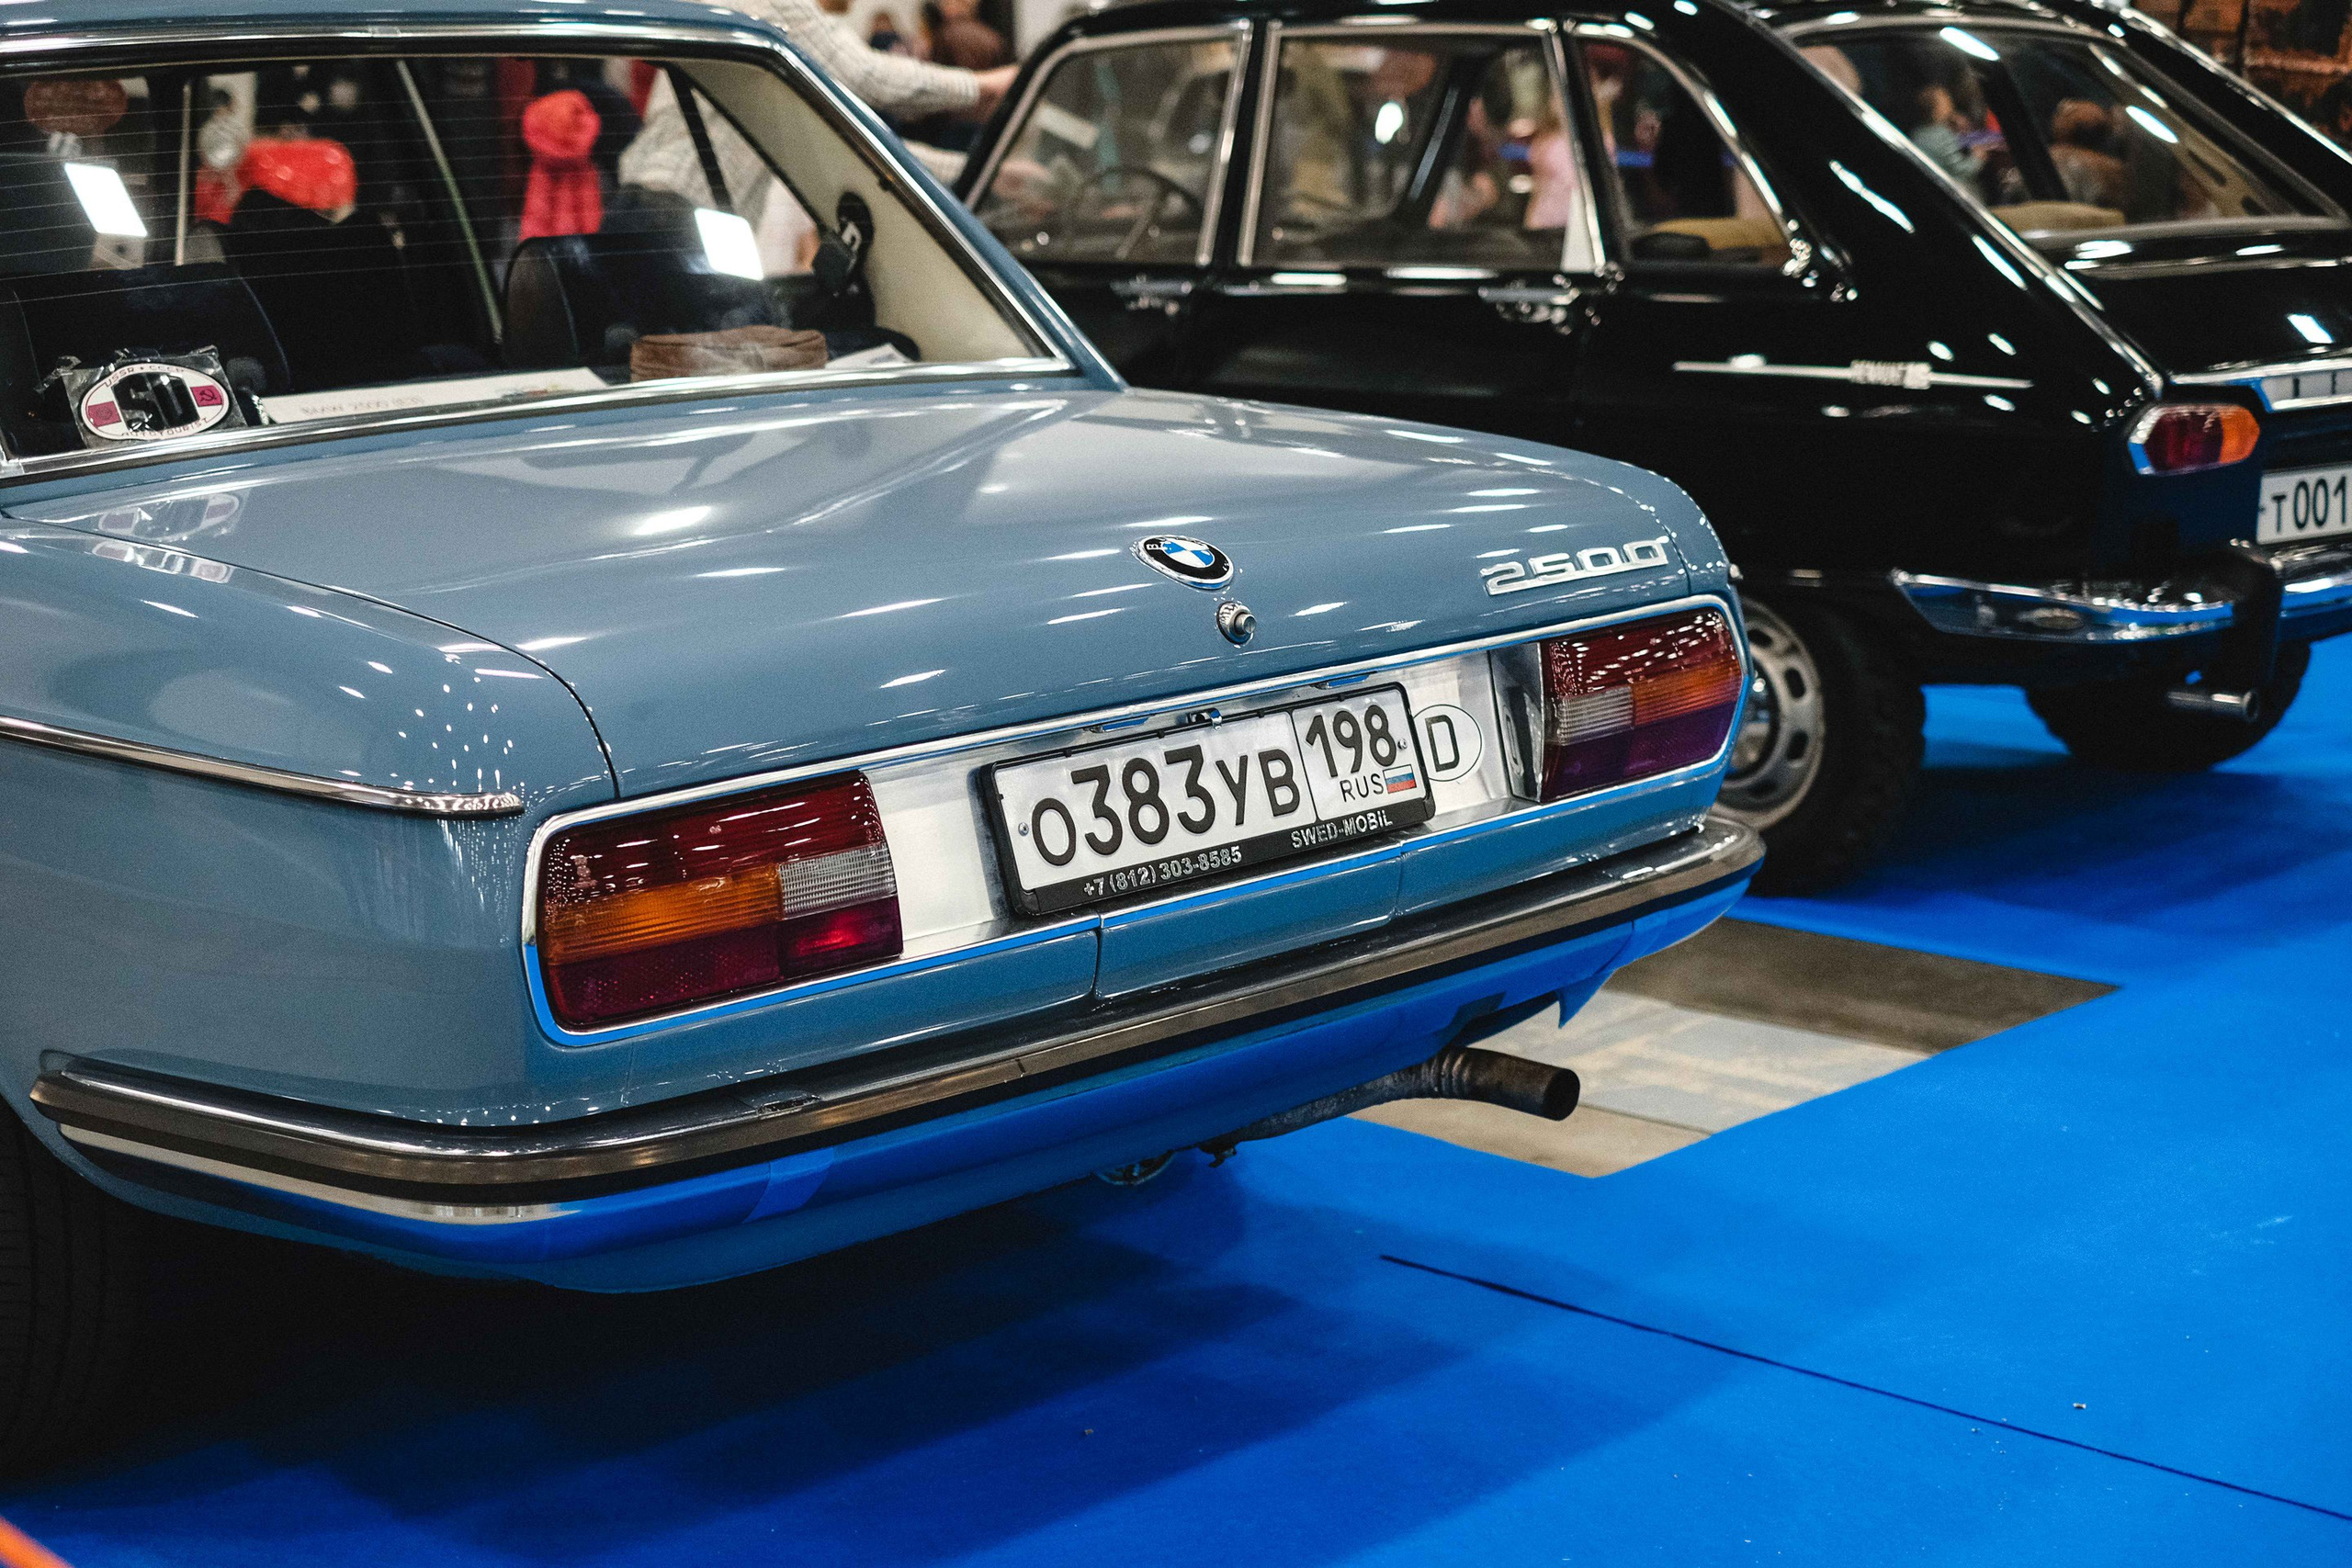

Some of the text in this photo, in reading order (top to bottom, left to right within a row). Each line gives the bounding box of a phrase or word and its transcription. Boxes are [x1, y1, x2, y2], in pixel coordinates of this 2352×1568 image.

[104, 367, 135, 388] USSR
[1480, 539, 1669, 597] 2500
[1305, 704, 1397, 779] 198
[1424, 714, 1460, 773] D
[1340, 773, 1384, 802] RUS
[1290, 809, 1393, 849] SWED-MOBIL
[1083, 844, 1243, 897] +7 (812) 303-8585
